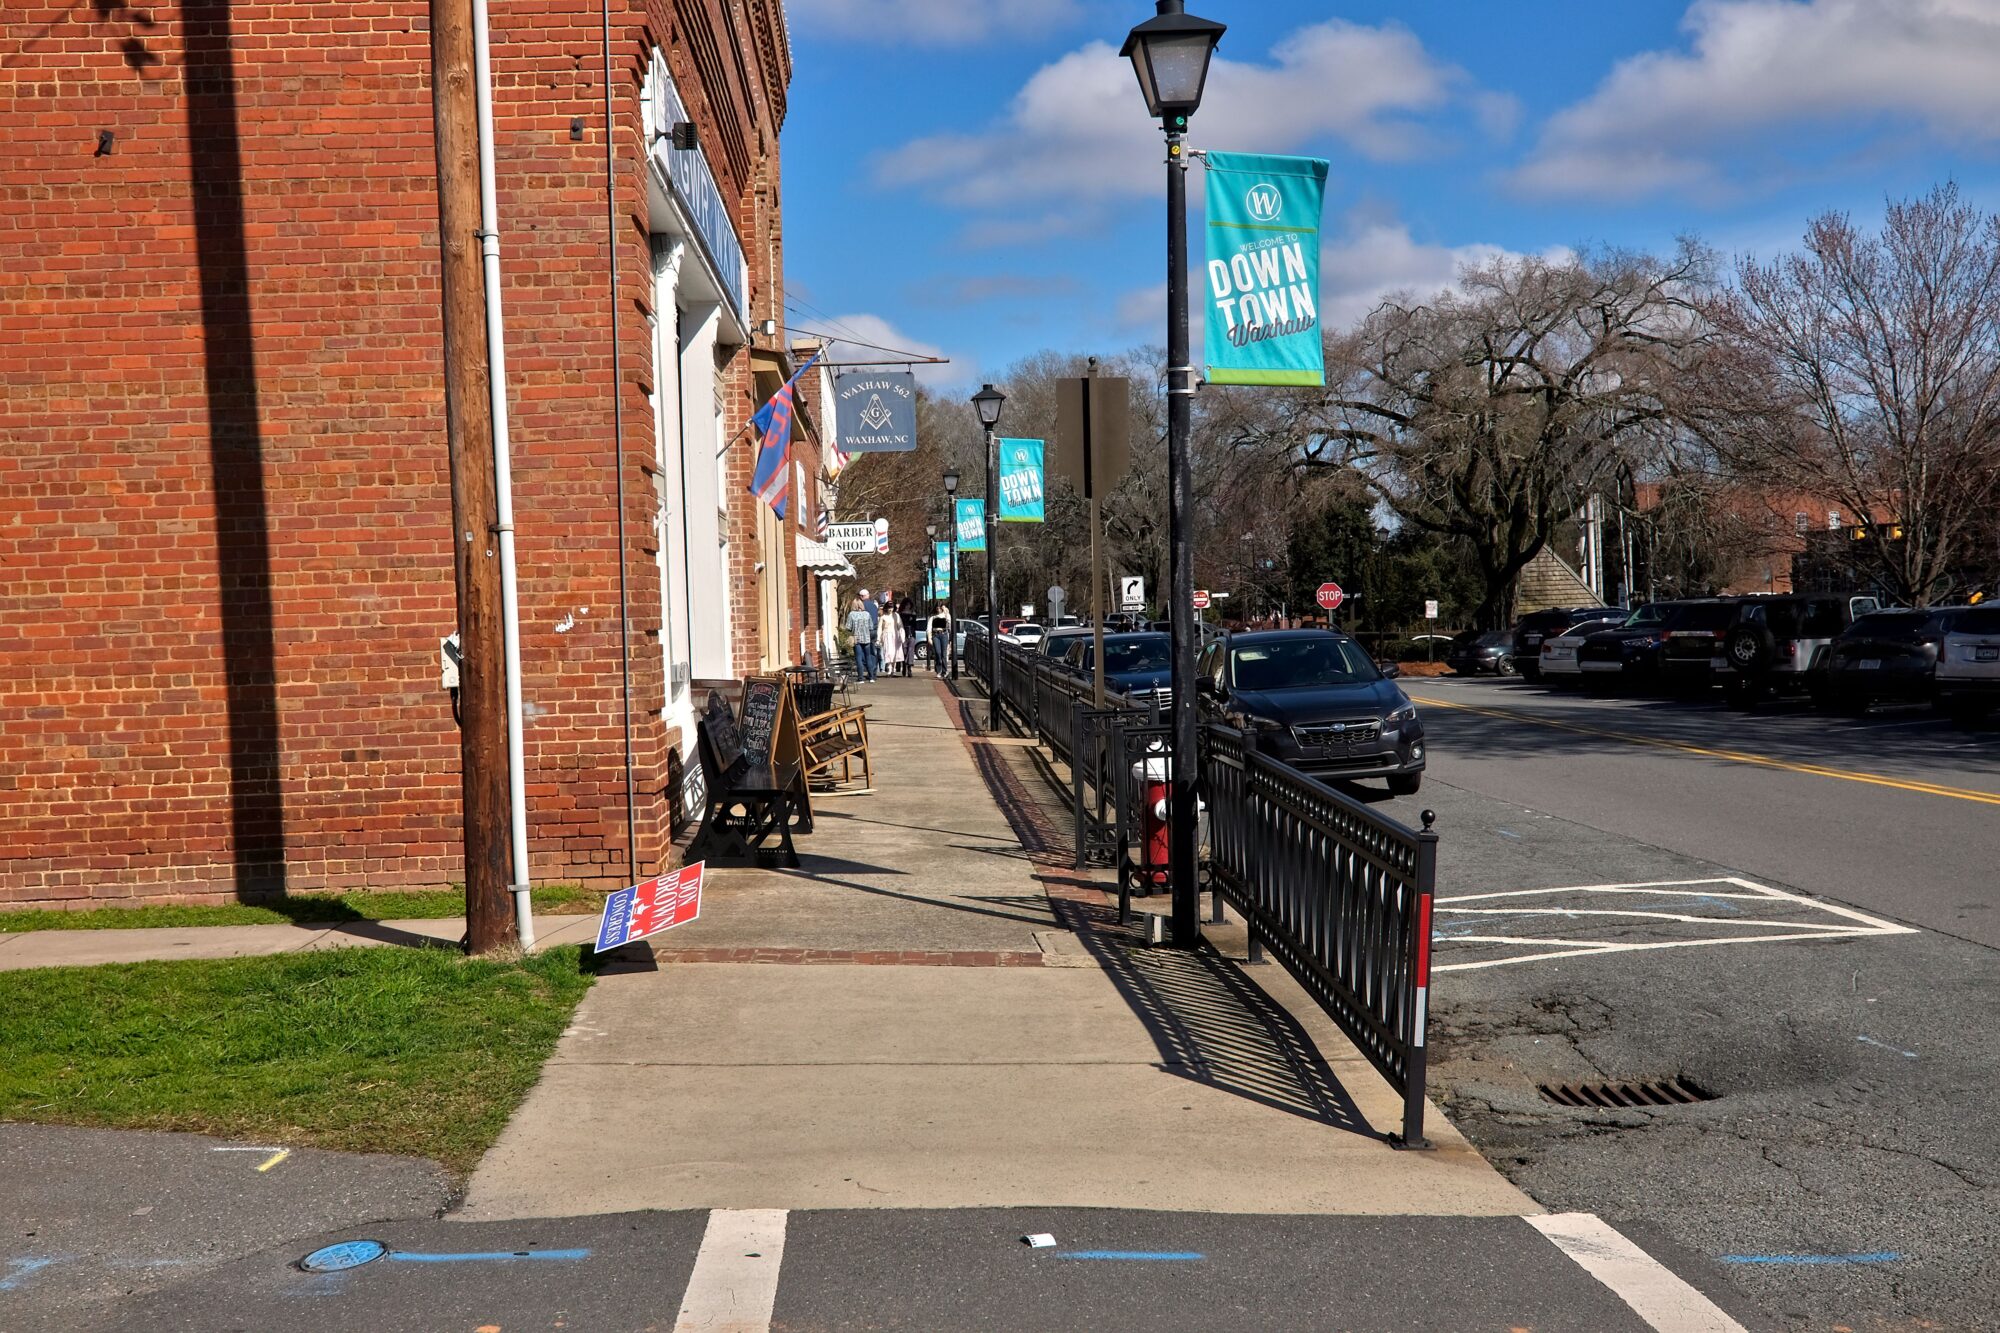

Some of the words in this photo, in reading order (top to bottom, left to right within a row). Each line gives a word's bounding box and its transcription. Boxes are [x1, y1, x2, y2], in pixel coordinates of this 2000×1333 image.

[1252, 191, 1278, 216] W
[1239, 235, 1285, 252] WELCOME
[1285, 233, 1298, 242] TO
[1208, 242, 1308, 299] DOWN
[1216, 282, 1316, 335] TOWN
[1226, 314, 1316, 348] Waxhaw
[840, 381, 892, 400] WAXHAW
[893, 384, 910, 399] 562
[871, 408, 880, 418] G
[845, 435, 893, 444] WAXHAW,
[894, 435, 909, 443] NC
[1001, 470, 1039, 491] DOWN
[1004, 484, 1042, 502] TOWN
[828, 527, 873, 538] BARBER
[957, 517, 983, 532] DOWN
[960, 528, 985, 540] TOWN
[836, 541, 866, 551] SHOP
[1319, 590, 1341, 601] STOP
[649, 871, 681, 932] BROWN
[677, 877, 699, 908] DON
[604, 893, 629, 945] CONGRESS
